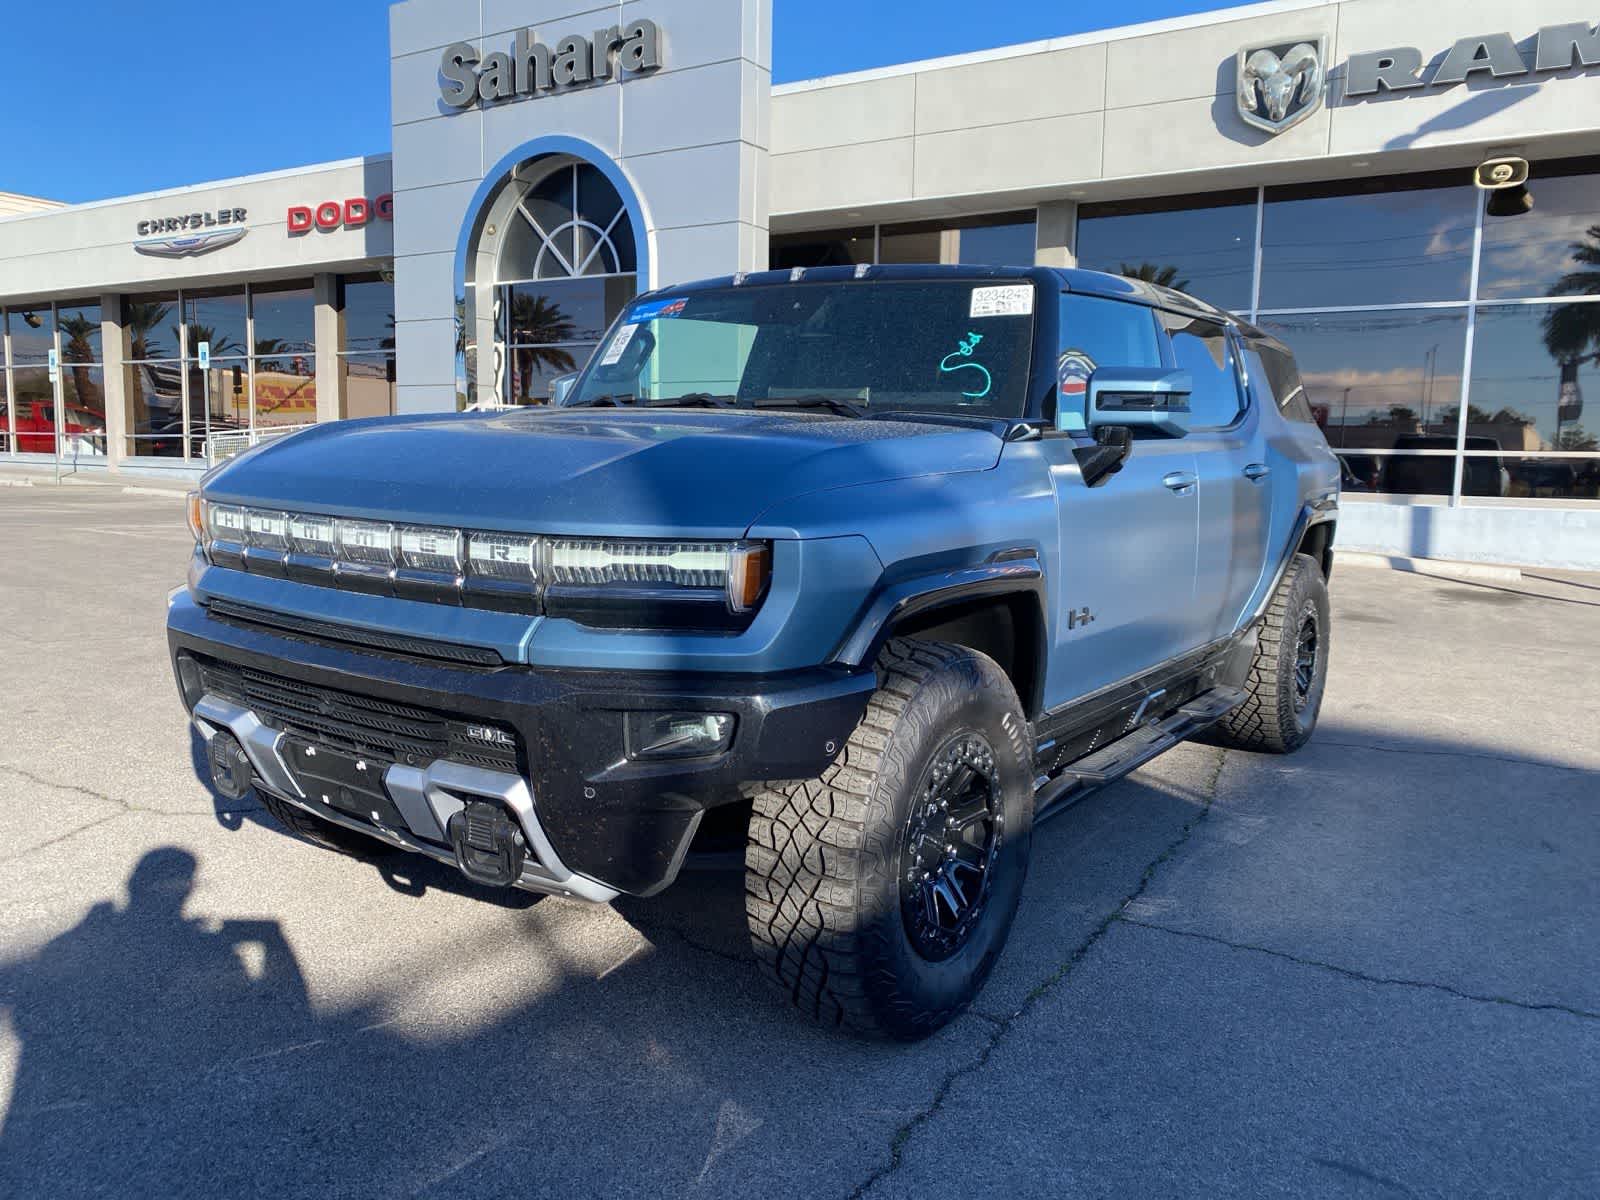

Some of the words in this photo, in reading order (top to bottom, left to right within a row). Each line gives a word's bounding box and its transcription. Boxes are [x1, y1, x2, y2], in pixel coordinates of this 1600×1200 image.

[440, 18, 661, 108] Sahara
[136, 206, 248, 236] CHRYSLER
[975, 288, 1030, 302] 3234243
[466, 725, 516, 746] GMC
